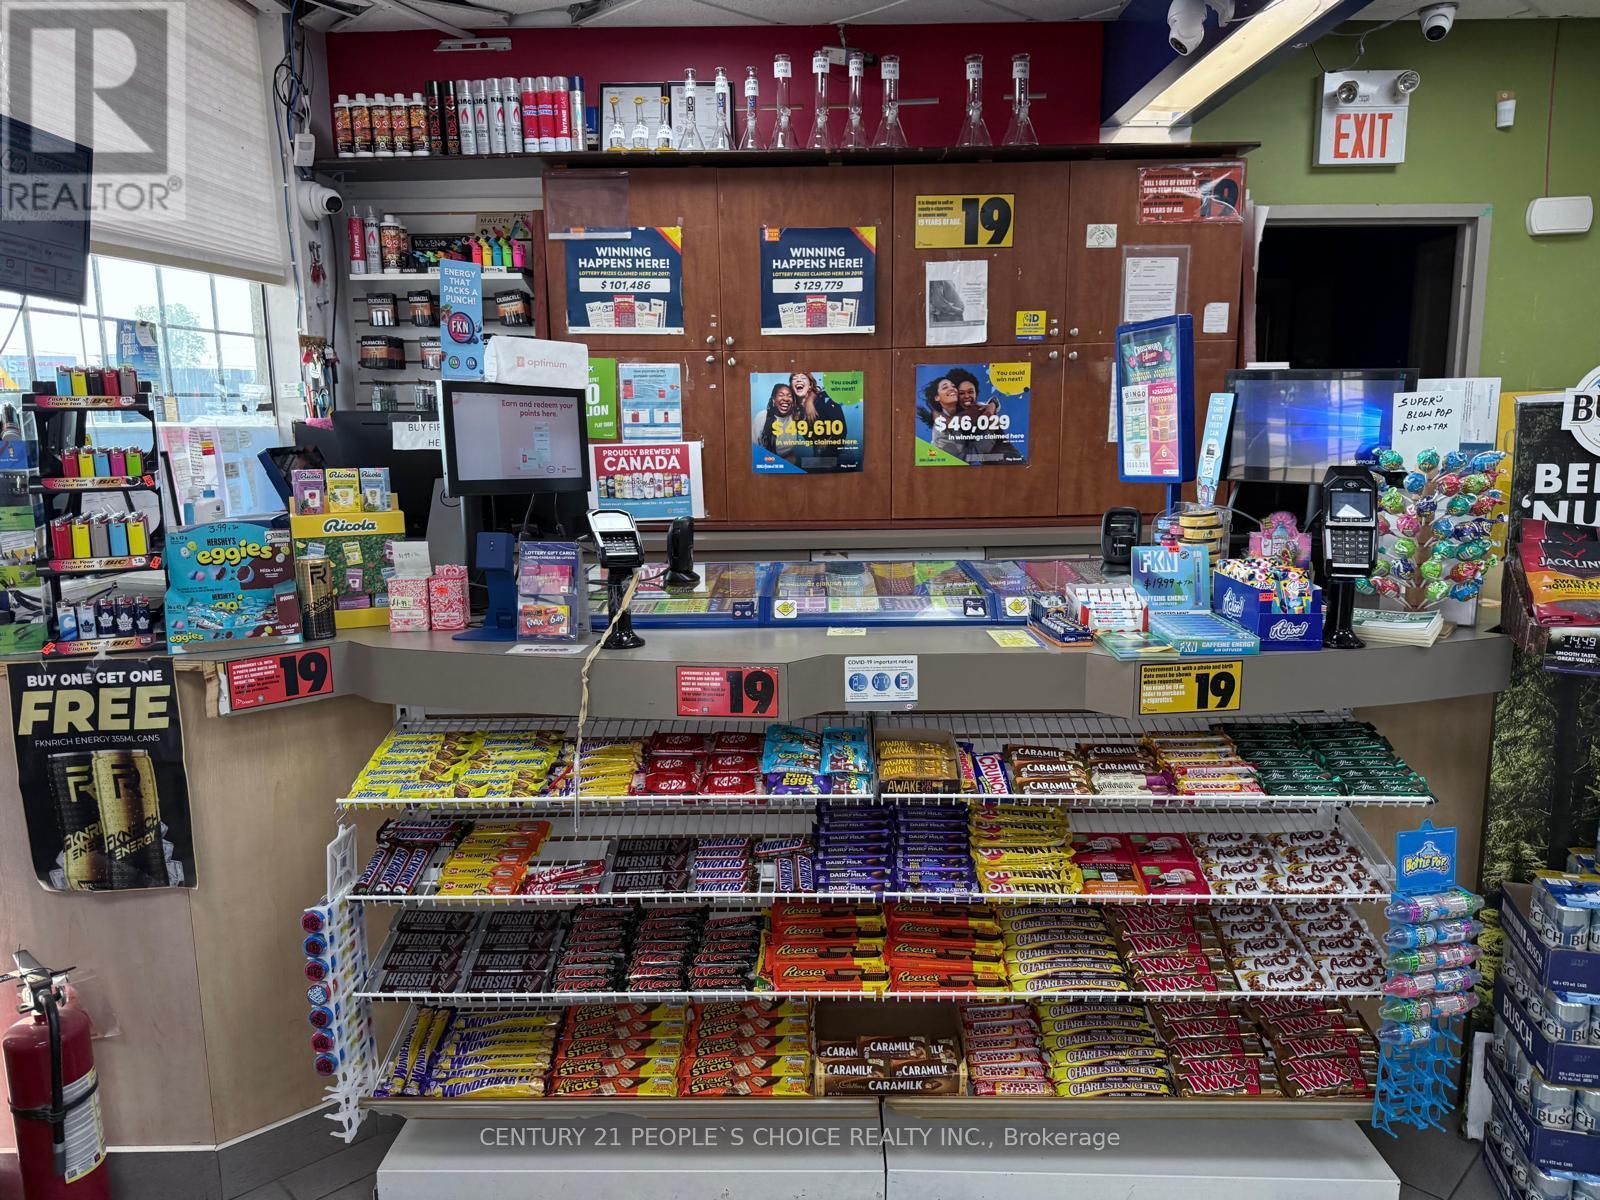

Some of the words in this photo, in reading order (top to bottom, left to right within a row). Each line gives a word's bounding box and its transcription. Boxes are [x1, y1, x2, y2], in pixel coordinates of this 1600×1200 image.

[1333, 113, 1393, 159] EXIT
[962, 197, 1012, 245] 19
[596, 247, 652, 257] WINNING
[790, 247, 845, 257] WINNING
[579, 259, 632, 268] HAPPENS
[636, 259, 670, 268] HERE!
[773, 259, 826, 269] HAPPENS
[830, 258, 863, 268] HERE!
[445, 268, 476, 278] ENERGY
[450, 278, 470, 287] THAT
[610, 281, 651, 291] 101,486
[804, 281, 844, 291] 129,779
[444, 286, 470, 296] PACKS
[472, 288, 478, 296] A
[446, 296, 476, 305] PUNCH!
[497, 294, 520, 303] DURACELL
[452, 320, 469, 335] FKN
[528, 358, 568, 369] optimum
[1125, 390, 1146, 399] BINGO
[1398, 397, 1436, 408] SUPER
[520, 410, 540, 418] points
[1407, 408, 1433, 420] BLOW
[1435, 407, 1453, 418] POP
[408, 424, 426, 432] BUY
[604, 456, 681, 471] CANADA
[300, 472, 321, 480] Ricola
[329, 470, 356, 479] Ricola
[361, 470, 382, 478] Ricola
[323, 519, 377, 534] Ricola
[207, 538, 236, 546] HERSHEY'S
[197, 540, 273, 565] eggies
[1139, 551, 1178, 573] FKN
[1539, 556, 1572, 568] JACK
[170, 632, 204, 643] eggies
[27, 675, 57, 687] BUY
[60, 673, 93, 686] ONE
[97, 671, 127, 684] GET
[130, 670, 163, 682] ONE
[280, 652, 328, 696] 19
[726, 671, 774, 714] 19
[1195, 672, 1236, 710] 19
[18, 685, 171, 736] FREE
[34, 738, 74, 748] FKNRICH
[75, 736, 110, 746] ENERGY
[111, 735, 136, 744] 355ML
[137, 734, 160, 742] CANS
[1018, 748, 1064, 759] CARAMILK
[1027, 764, 1074, 773] CARAMILK
[1098, 763, 1145, 772] CARAMILK
[888, 782, 920, 794] AWAKE
[1030, 782, 1078, 791] CARAMILK
[1290, 830, 1323, 842] Aero
[700, 837, 747, 848] SNICKERS
[755, 839, 803, 851] SNICKERS
[385, 848, 408, 886] SNICKERS
[617, 855, 678, 867] HERSHEY'S
[694, 859, 744, 869] SNICKERS
[1221, 863, 1258, 876] Aero
[1287, 874, 1323, 887] Aero
[783, 966, 827, 977] Reese's
[898, 971, 939, 982] Reese's
[386, 973, 448, 986] HERSHEY'S
[471, 976, 532, 989] HERSHEY'S
[1139, 976, 1200, 992] TWIX
[1268, 971, 1304, 985] Aero
[1336, 977, 1373, 990] Aero
[1026, 980, 1090, 992] CHARLESTON
[1092, 980, 1120, 988] CHEW
[1503, 1001, 1534, 1052] BUSCH
[870, 1041, 915, 1052] CARAMILK
[442, 1076, 516, 1098] WUNDERBAR
[868, 1080, 923, 1091] CARAMILK
[1070, 1084, 1134, 1096] CHARLESTON
[1135, 1083, 1161, 1091] CHEW
[1180, 1074, 1244, 1094] TWIX
